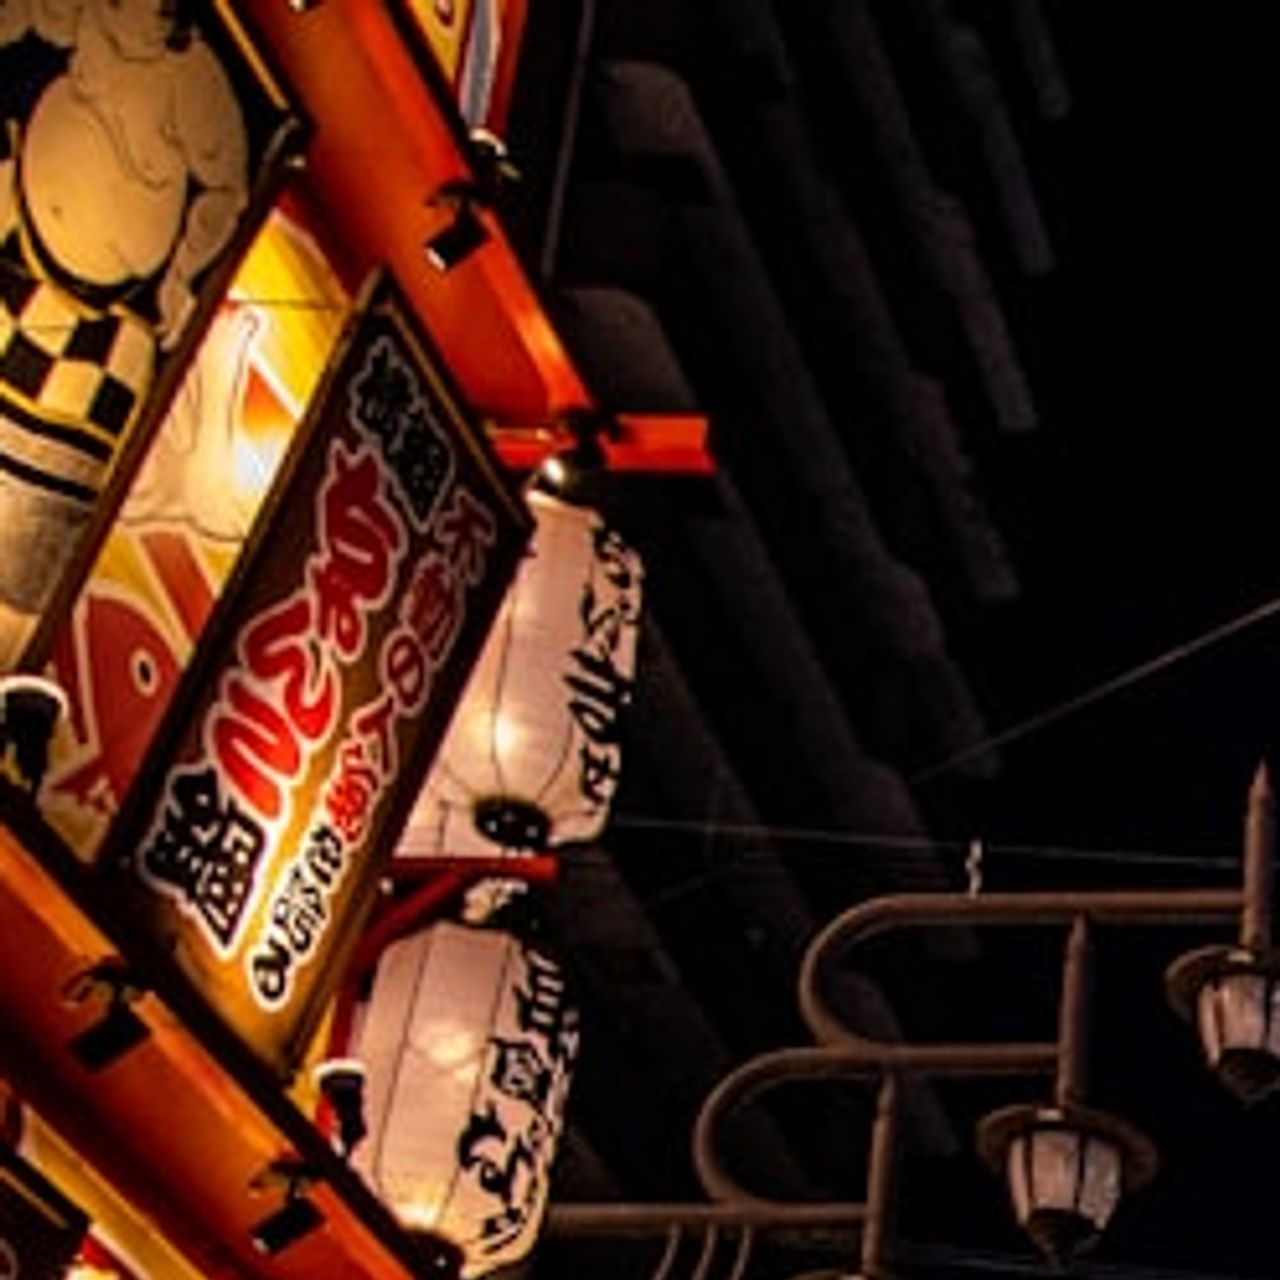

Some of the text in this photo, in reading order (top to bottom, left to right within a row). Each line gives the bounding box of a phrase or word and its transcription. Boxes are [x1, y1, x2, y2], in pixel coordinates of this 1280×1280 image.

[138, 440, 402, 962] ちゃんこ鍋
